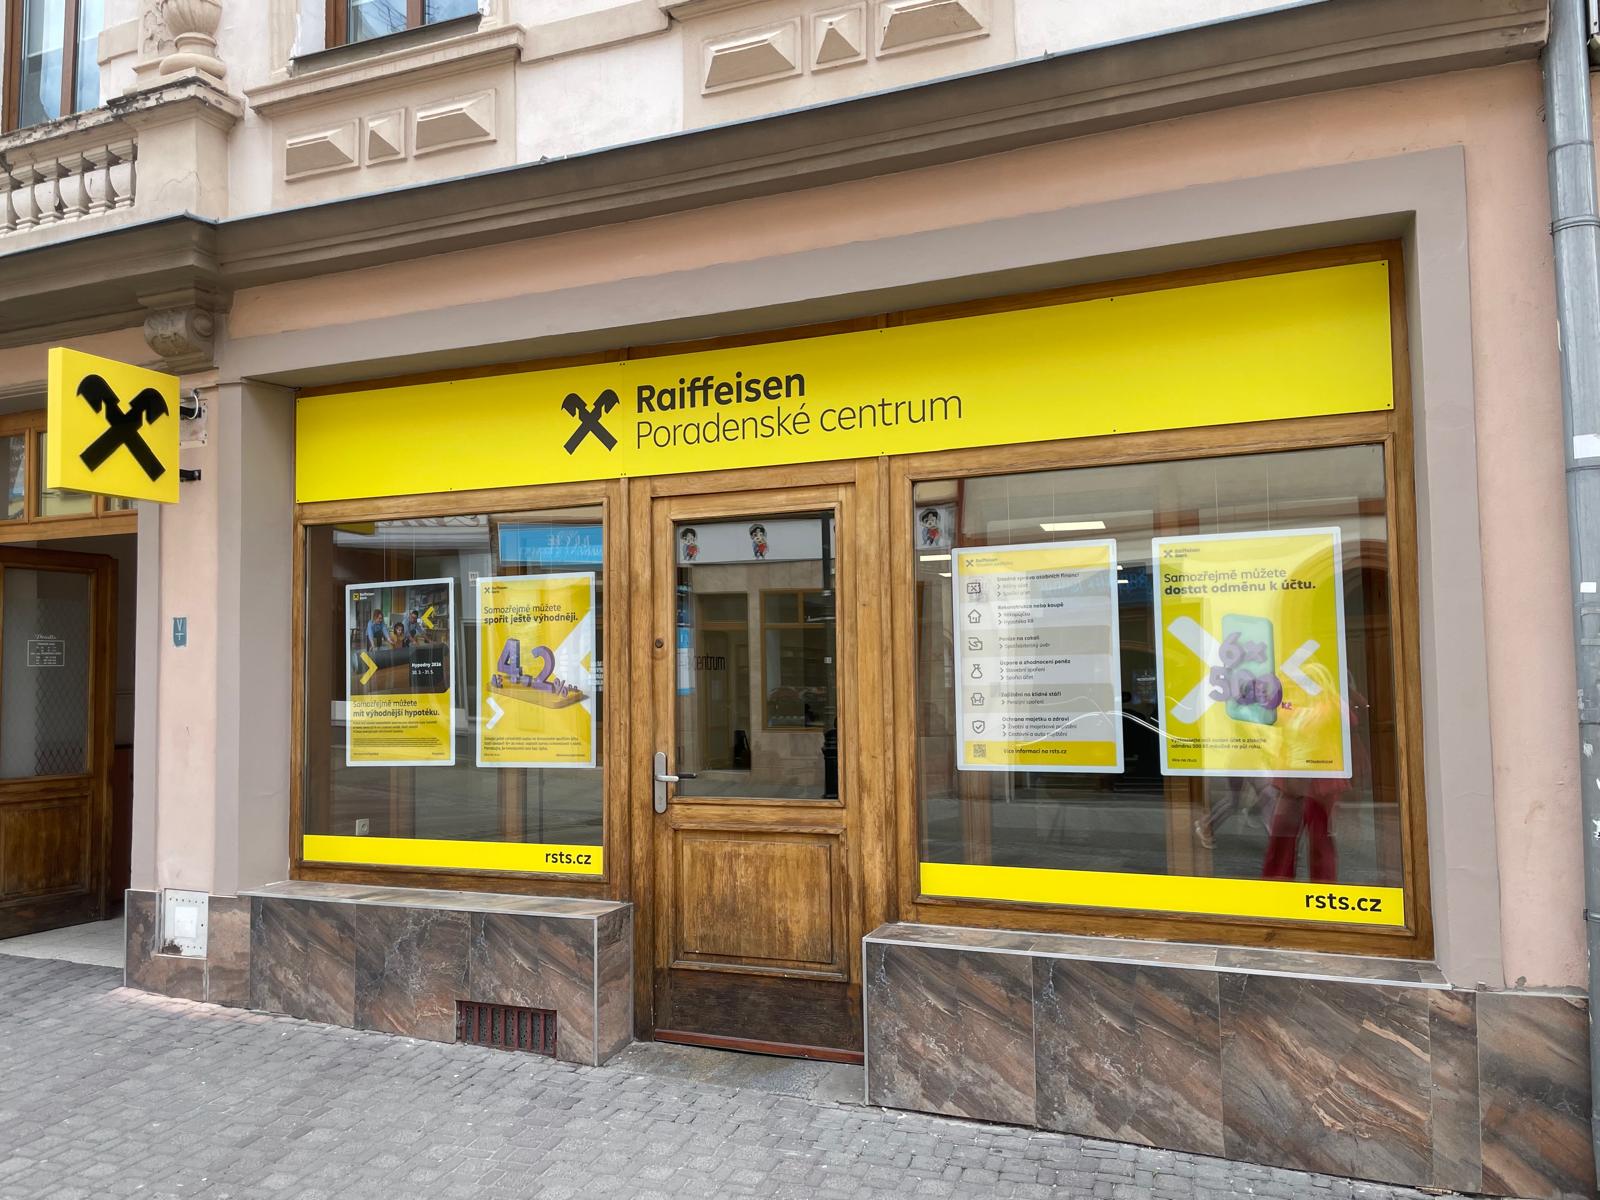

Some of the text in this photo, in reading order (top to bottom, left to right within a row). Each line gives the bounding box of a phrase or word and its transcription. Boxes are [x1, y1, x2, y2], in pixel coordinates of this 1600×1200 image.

[637, 371, 805, 414] Raiffeisen
[637, 394, 962, 449] Poradenské centrum
[1164, 568, 1287, 583] Samozřejmě můžete
[1164, 579, 1316, 595] dostat odměnu k účtu.
[484, 603, 561, 615] Samozřejmě můžete
[484, 612, 578, 625] spořit ještě výhodněji.
[1218, 632, 1268, 668] 6x
[1208, 665, 1283, 710] 500
[353, 698, 417, 709] Samozřejmě můžete
[365, 709, 403, 718] výhodnější
[404, 708, 440, 717] hypotéku.
[545, 851, 592, 865] rsts.cz
[1305, 893, 1382, 912] rsts.cz
